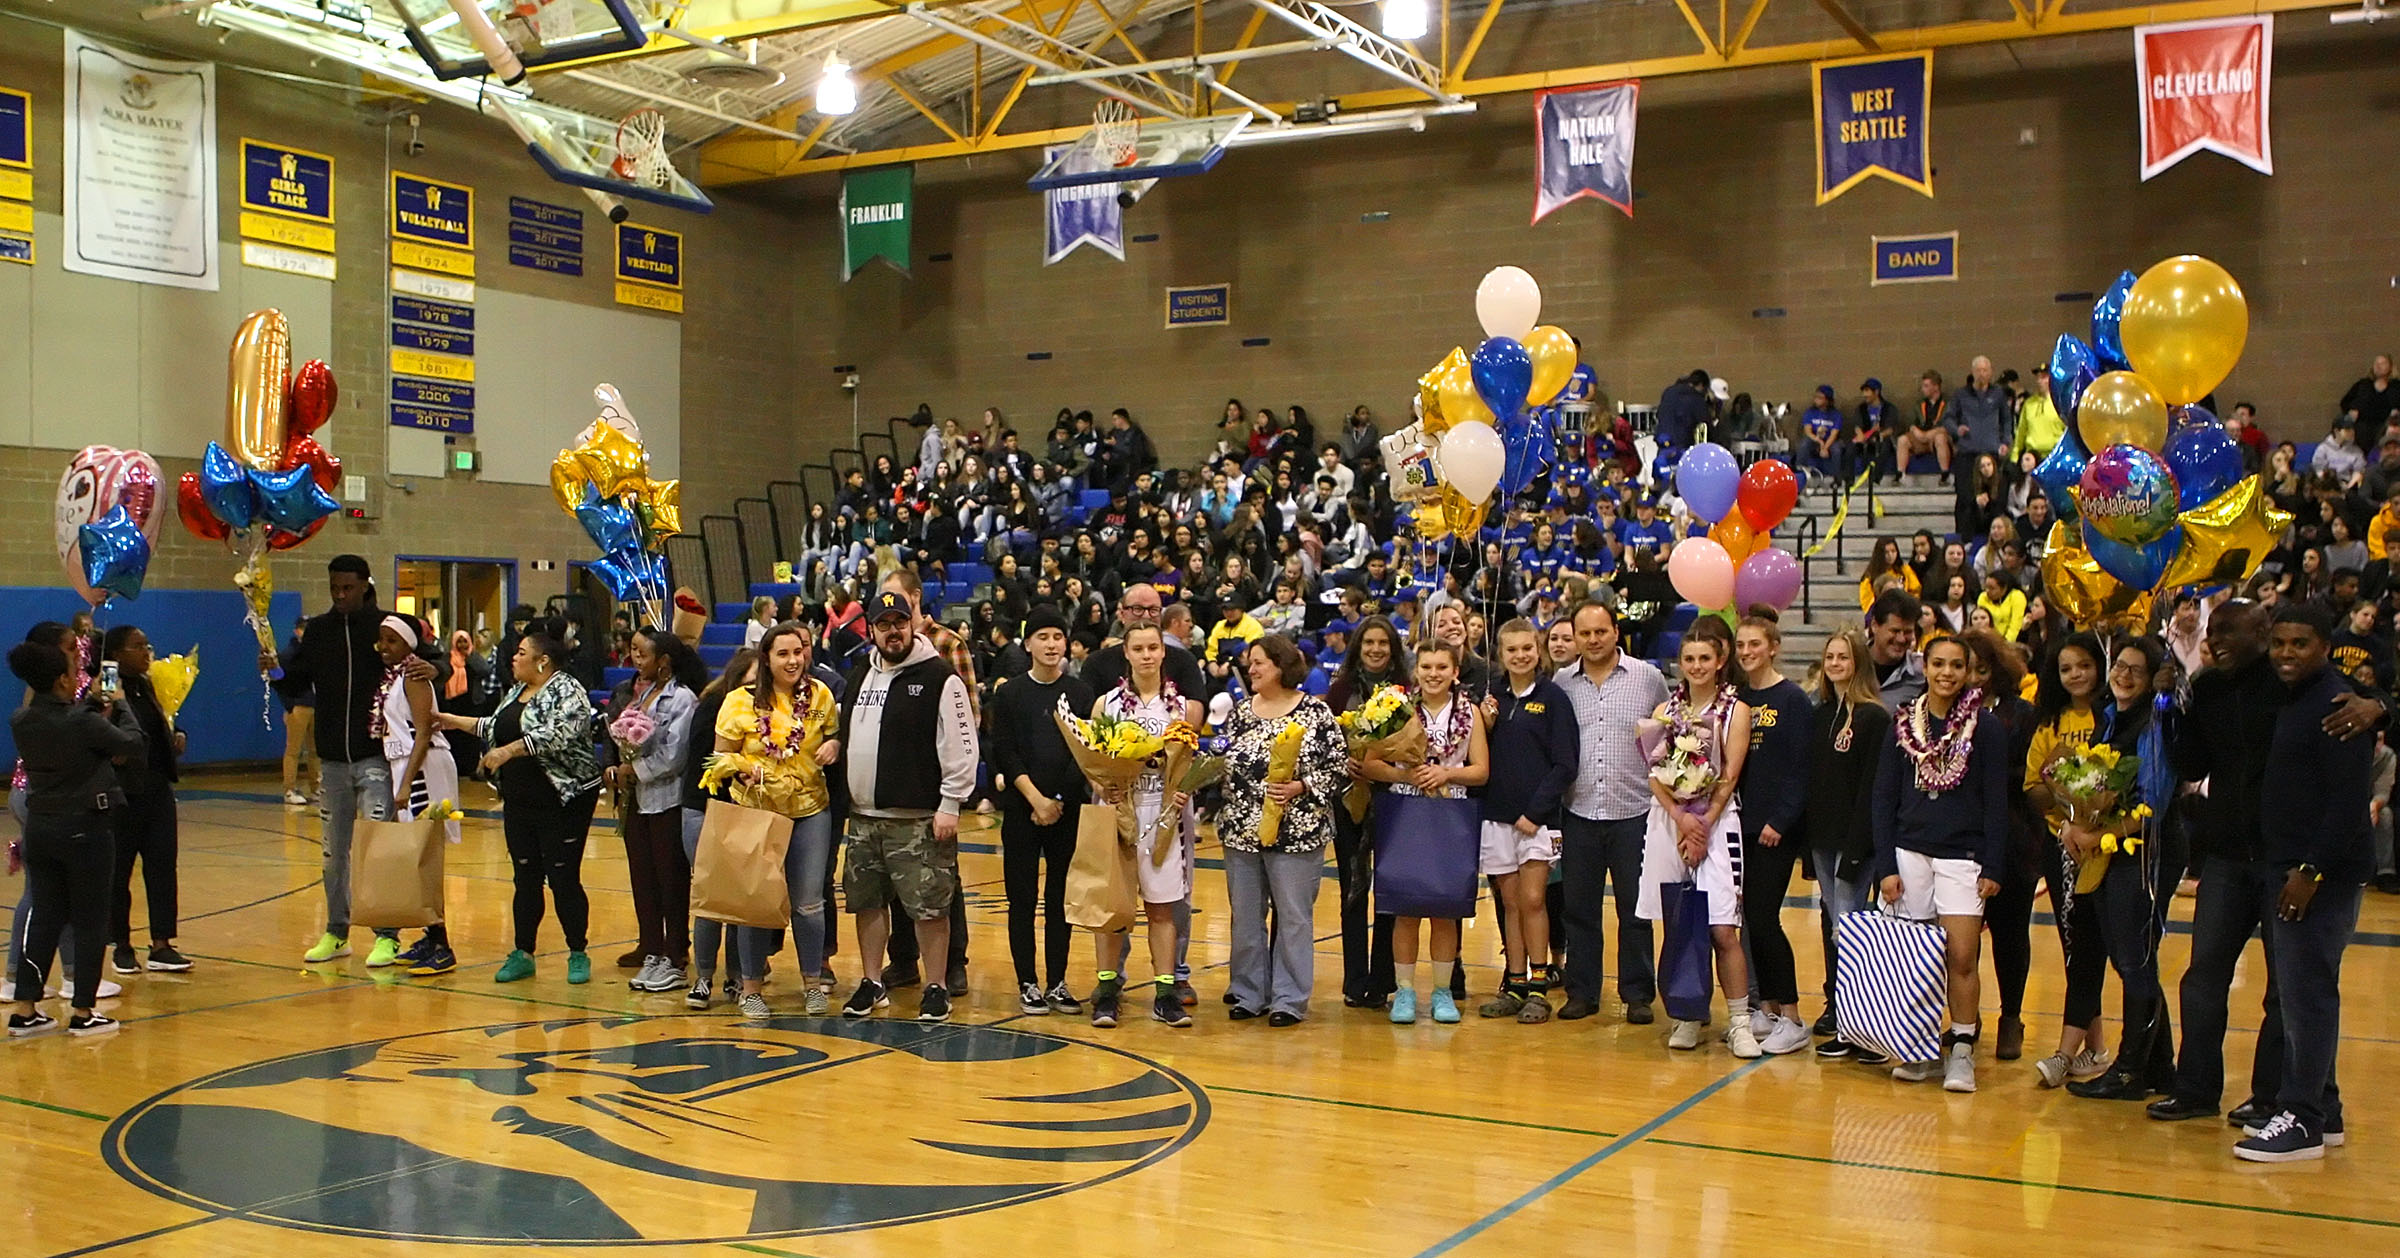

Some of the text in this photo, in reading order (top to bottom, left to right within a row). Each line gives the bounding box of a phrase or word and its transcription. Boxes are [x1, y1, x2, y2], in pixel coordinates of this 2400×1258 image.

[2153, 68, 2252, 99] CLEVELAND
[1851, 87, 1894, 113] WEST
[1559, 115, 1614, 140] NATHAN
[1841, 115, 1907, 144] SEATTLE
[1570, 143, 1604, 166] HALE
[270, 178, 305, 195] GIRLS
[268, 190, 308, 209] TRACK
[400, 210, 466, 234] VOLLEYBALL
[850, 202, 904, 225] FRANKLIN
[1889, 249, 1941, 268] BAND
[1178, 293, 1219, 305] VISITING
[420, 309, 449, 323] 1978
[1173, 306, 1224, 318] STUDENTS
[419, 336, 450, 350] 1979
[419, 362, 448, 375] 1981
[418, 390, 450, 403] 2006
[416, 415, 450, 428] 2010
[1406, 457, 1439, 487] #1
[954, 690, 973, 756] HUSKIES
